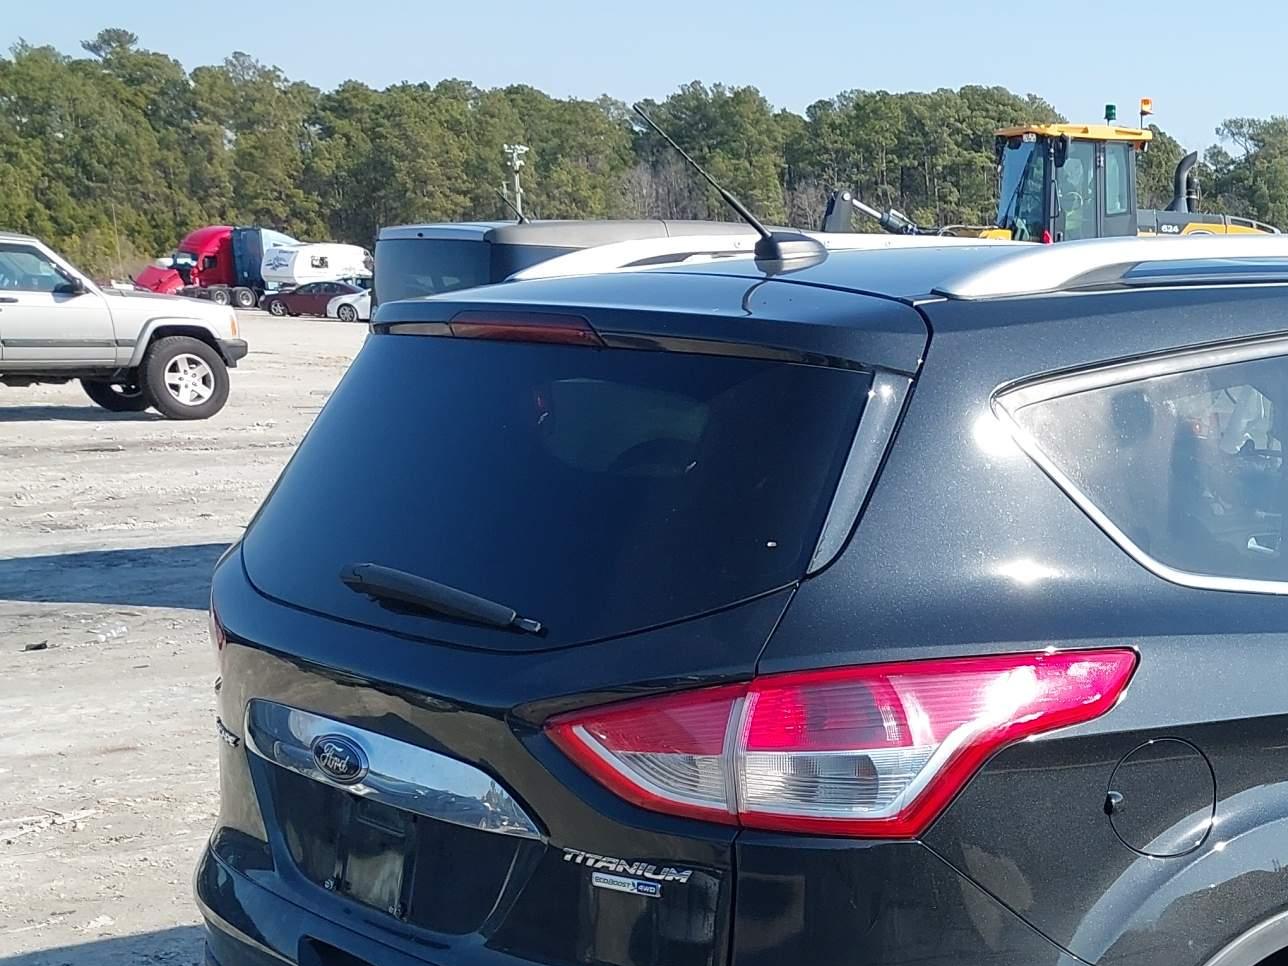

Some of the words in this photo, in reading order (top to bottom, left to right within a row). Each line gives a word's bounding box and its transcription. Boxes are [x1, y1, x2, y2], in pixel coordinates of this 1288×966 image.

[320, 742, 350, 773] Ford
[562, 847, 693, 884] TITANIUM
[638, 884, 656, 893] 4WD
